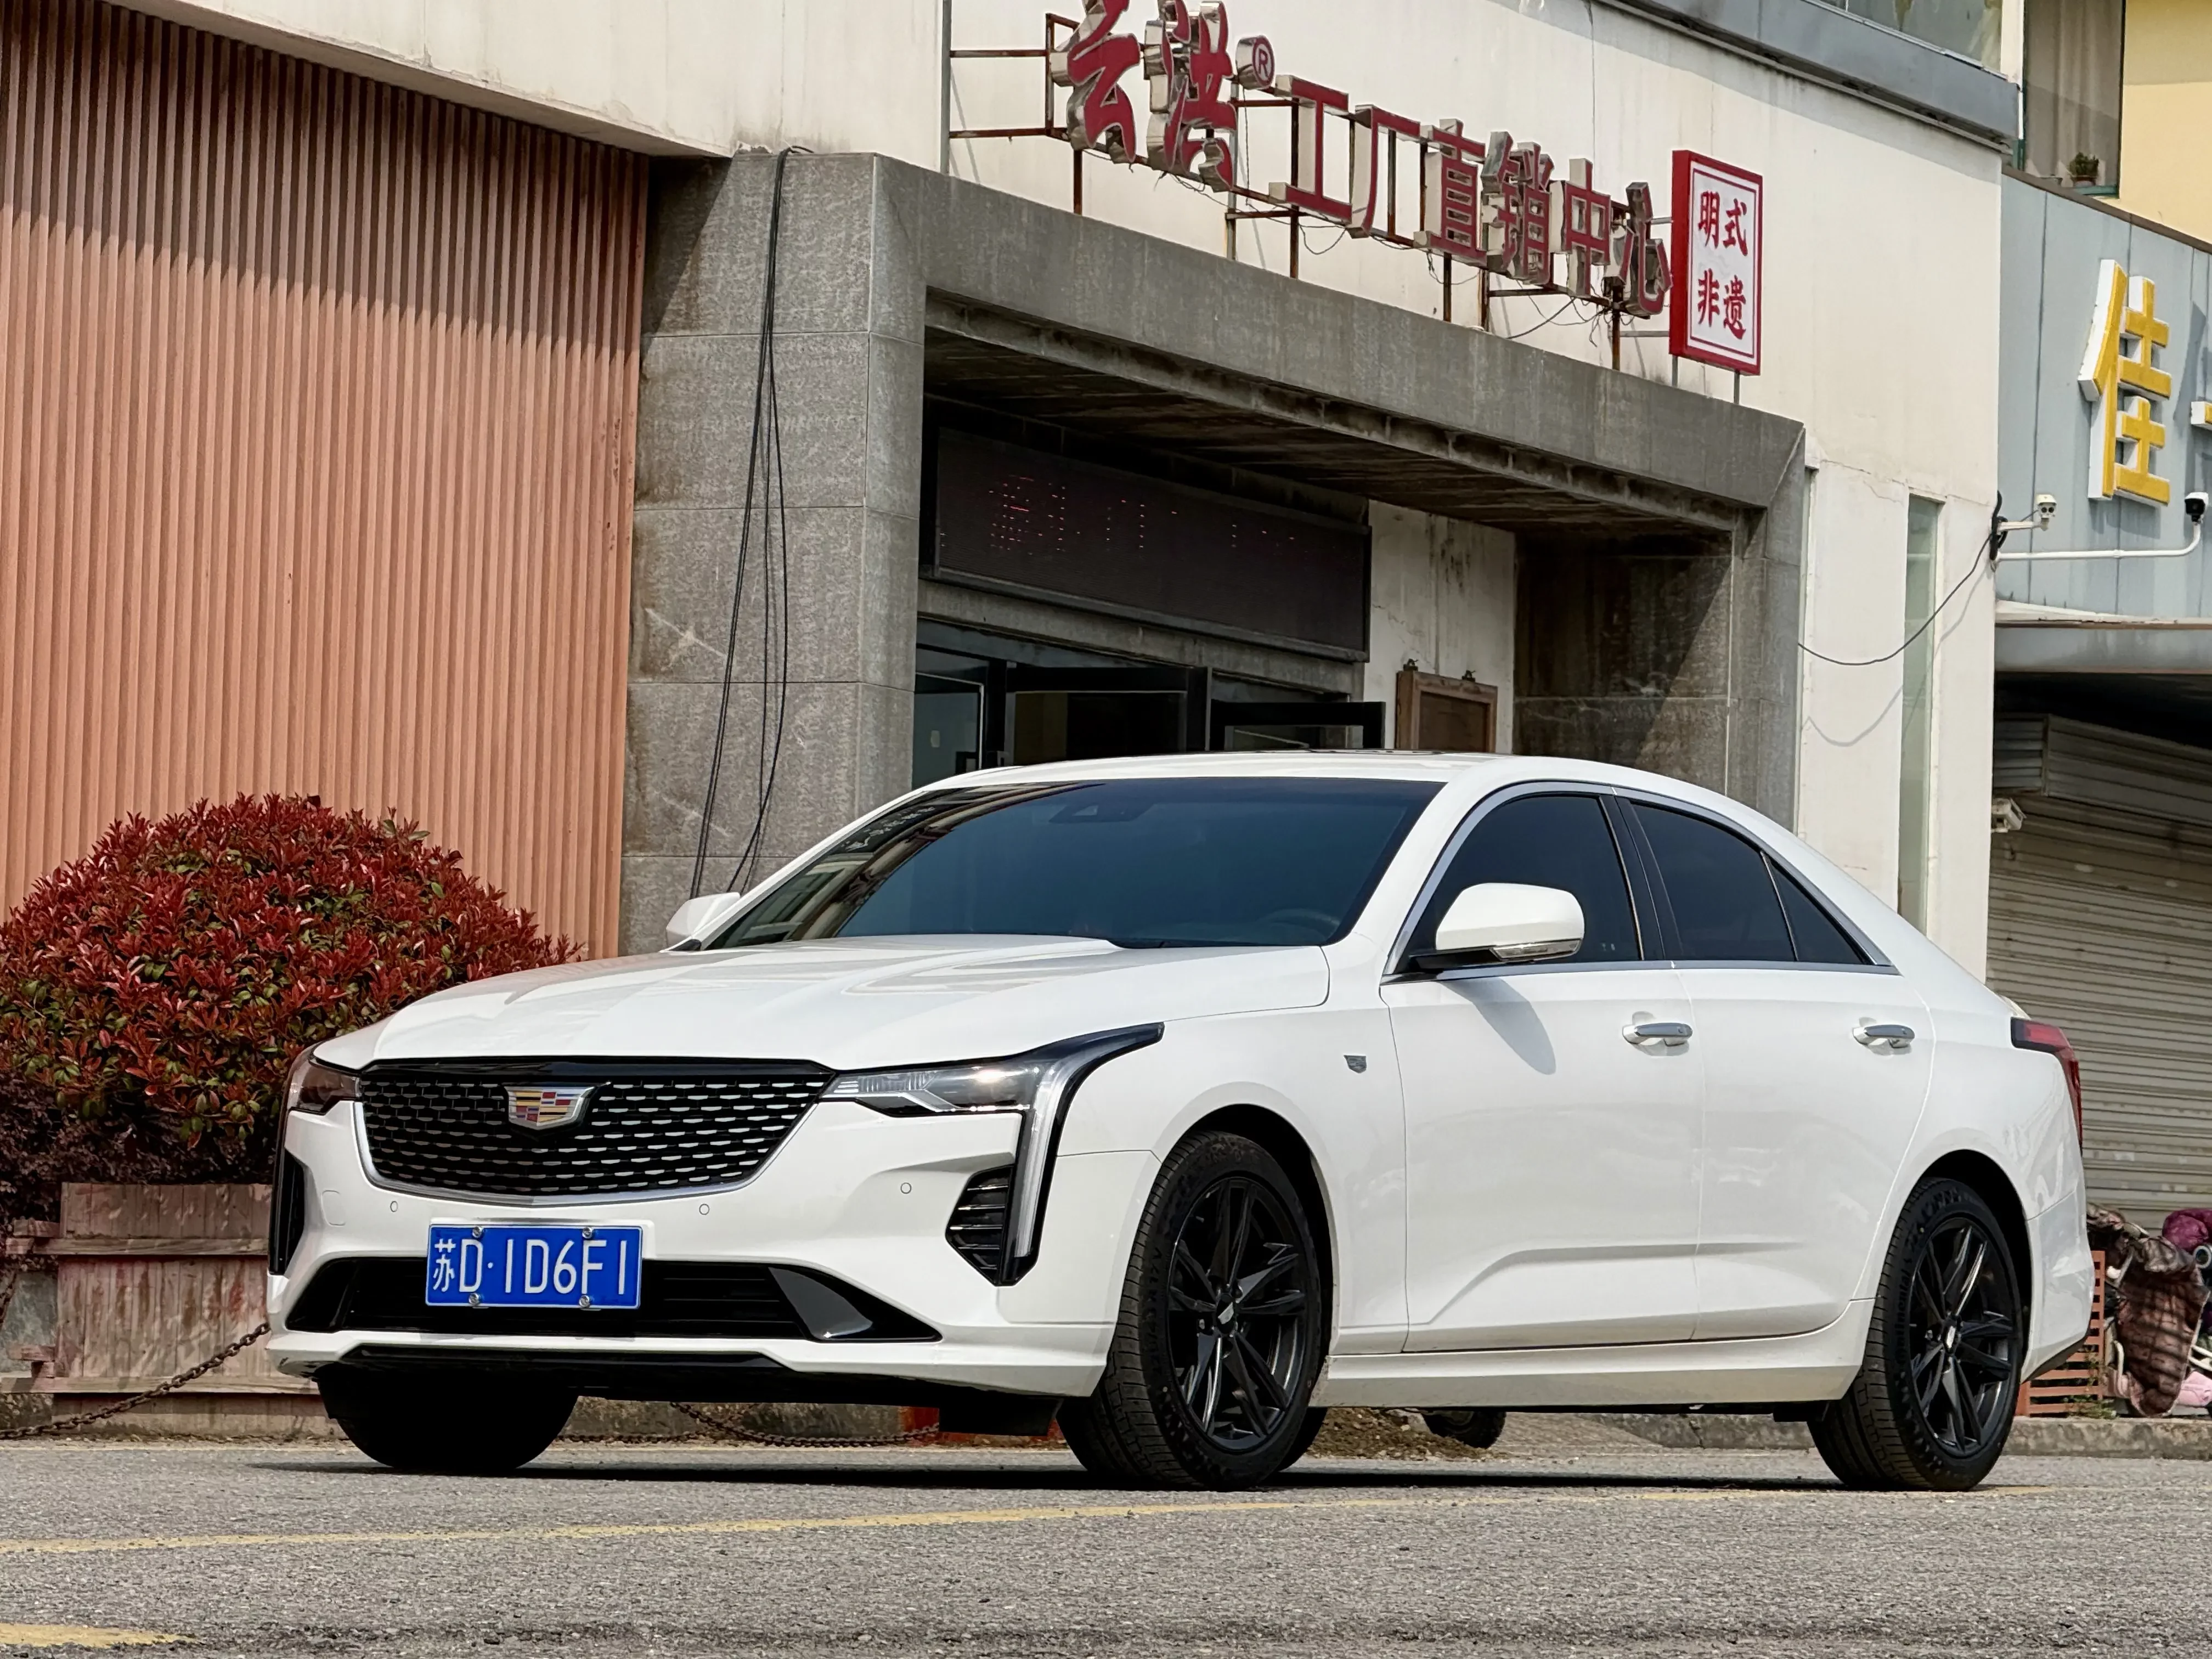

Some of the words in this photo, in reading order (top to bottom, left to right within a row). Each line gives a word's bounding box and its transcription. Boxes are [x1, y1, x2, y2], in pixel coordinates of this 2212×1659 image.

[1271, 75, 1673, 315] 工厂直销中心
[1697, 191, 1749, 257] 明式
[1696, 269, 1747, 340] 非遗
[2078, 259, 2212, 508] 佳
[432, 1238, 628, 1295] 苏D·1D6F1
